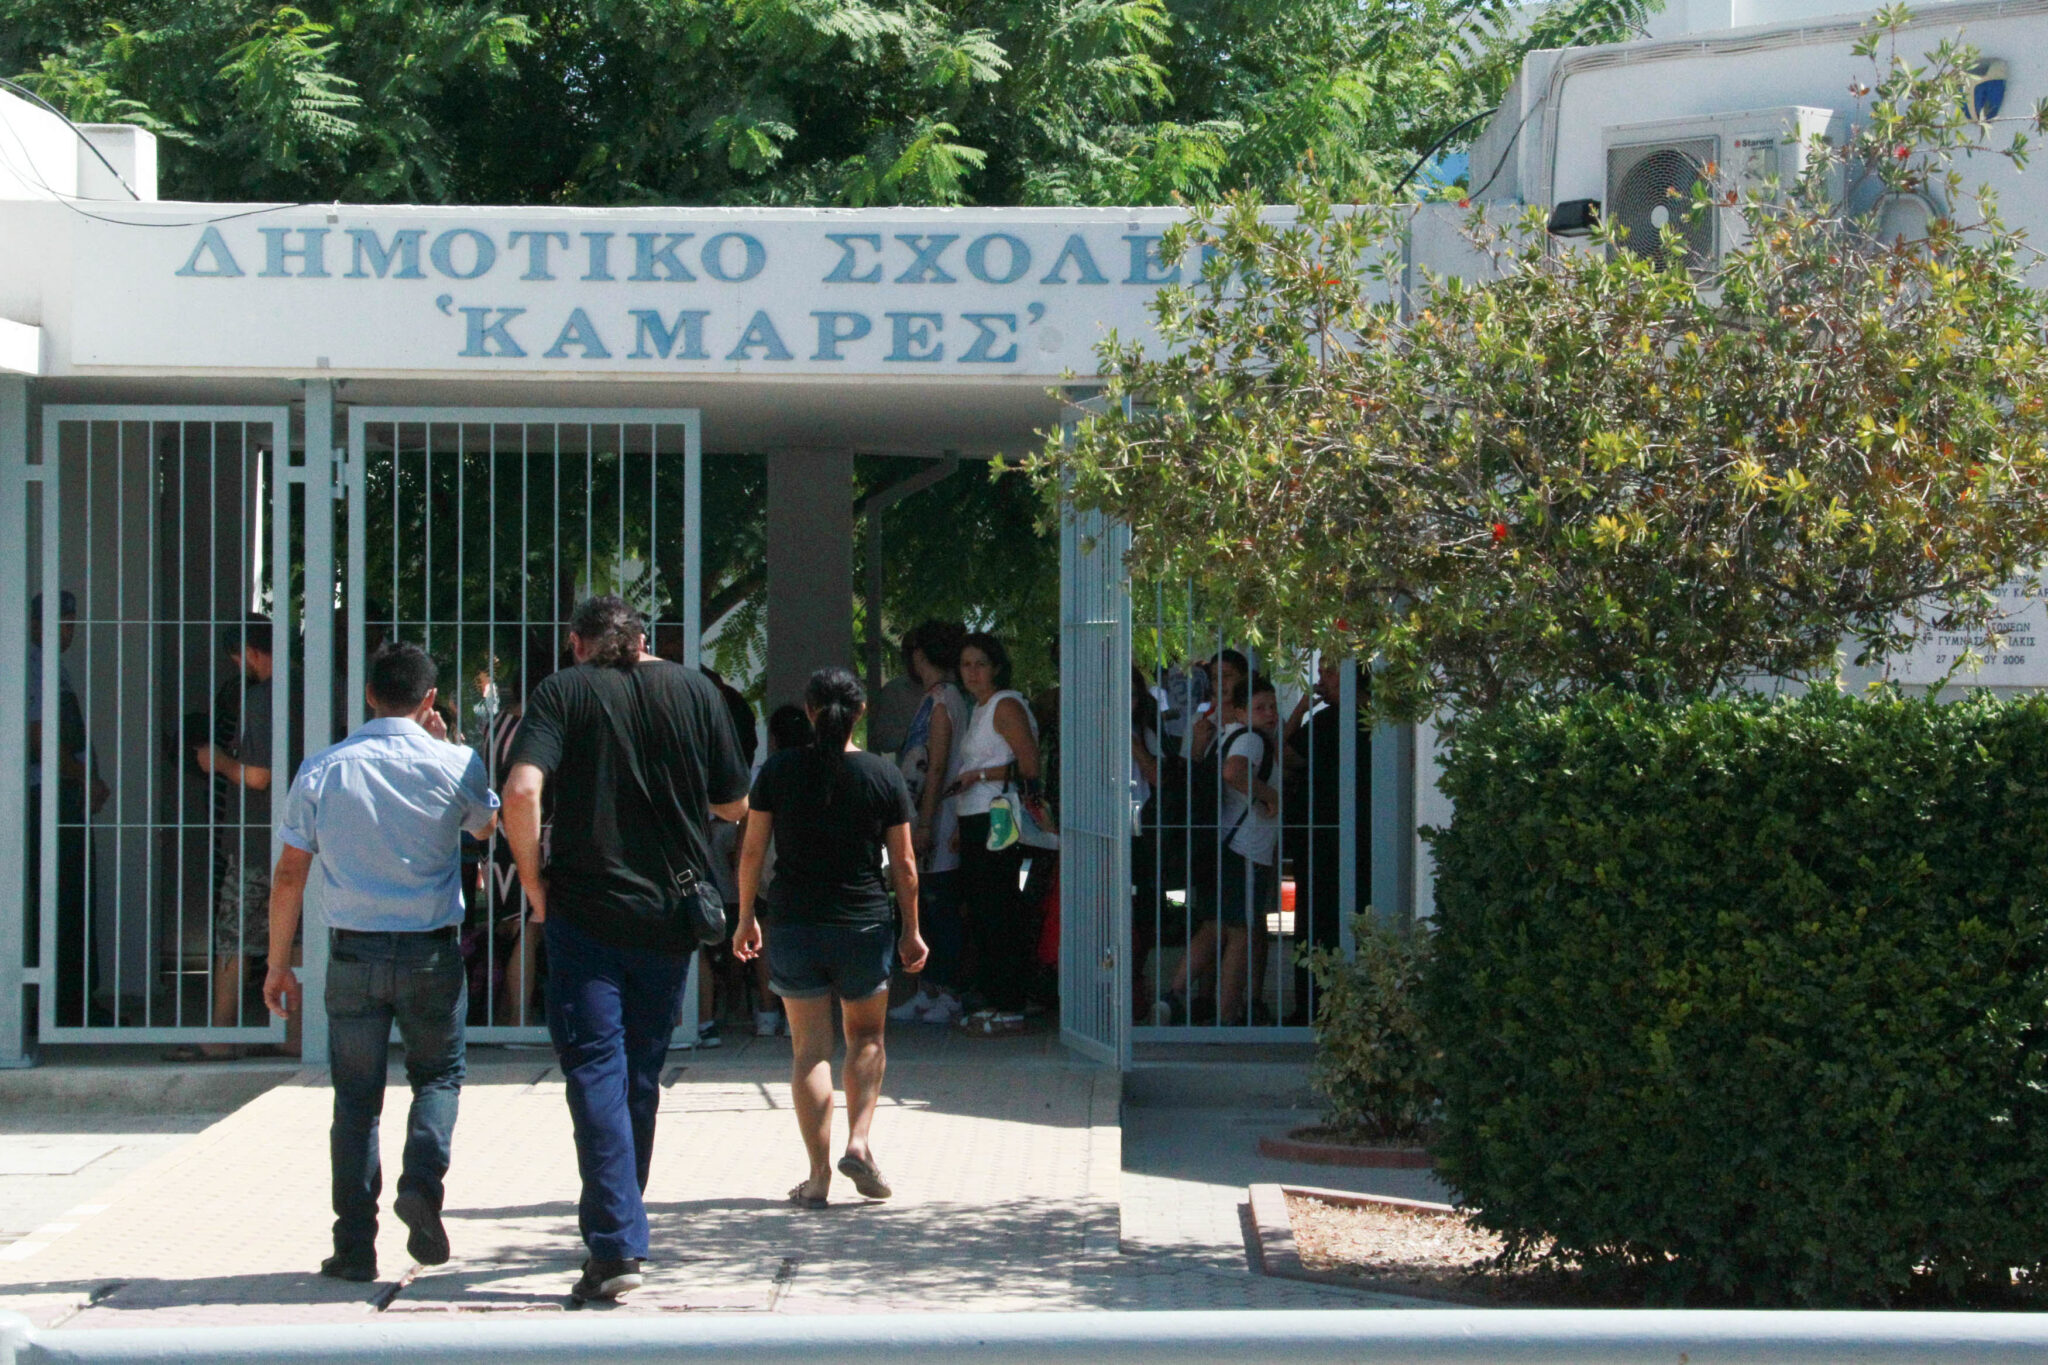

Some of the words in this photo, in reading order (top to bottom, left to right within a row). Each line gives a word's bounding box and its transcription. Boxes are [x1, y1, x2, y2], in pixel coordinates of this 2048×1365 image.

[174, 226, 768, 284] ΔΗΜΟΤΙΚΟ
[1936, 655, 1947, 664] 27
[2003, 656, 2026, 665] 2006
